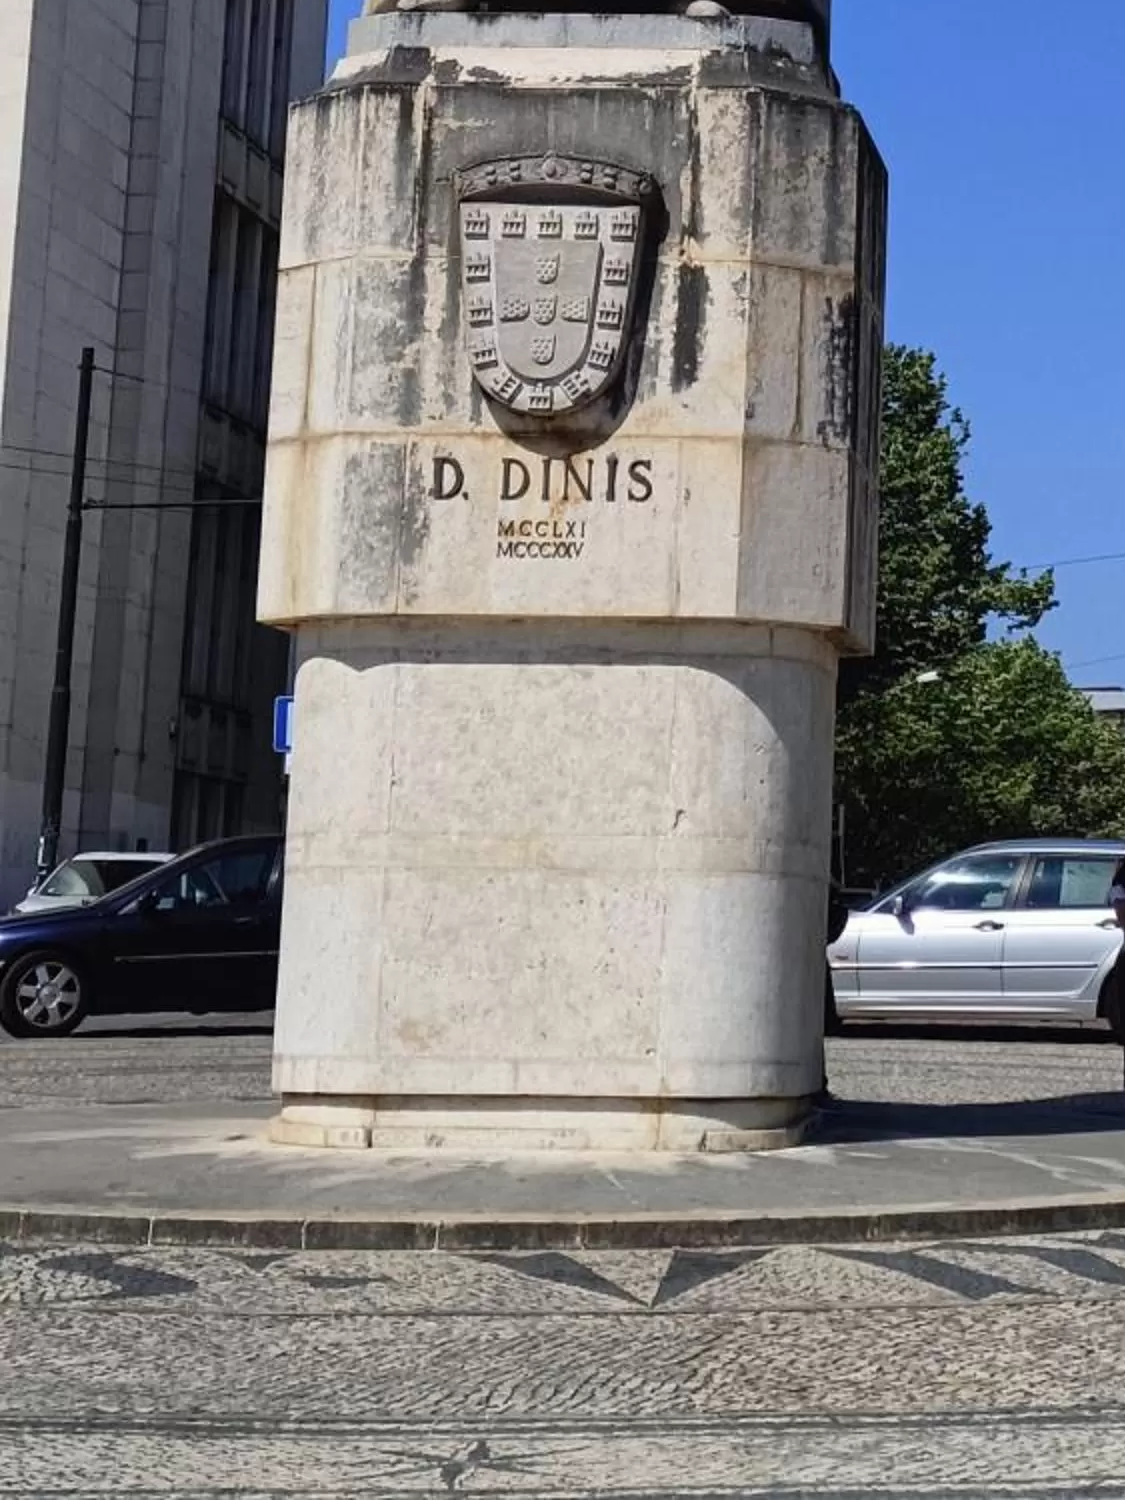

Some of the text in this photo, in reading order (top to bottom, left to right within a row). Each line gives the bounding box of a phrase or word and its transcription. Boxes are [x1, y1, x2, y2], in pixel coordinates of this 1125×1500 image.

[432, 453, 653, 502] D. DINIS
[498, 519, 585, 537] MCCLXI
[496, 542, 584, 559] MCCCXXV
